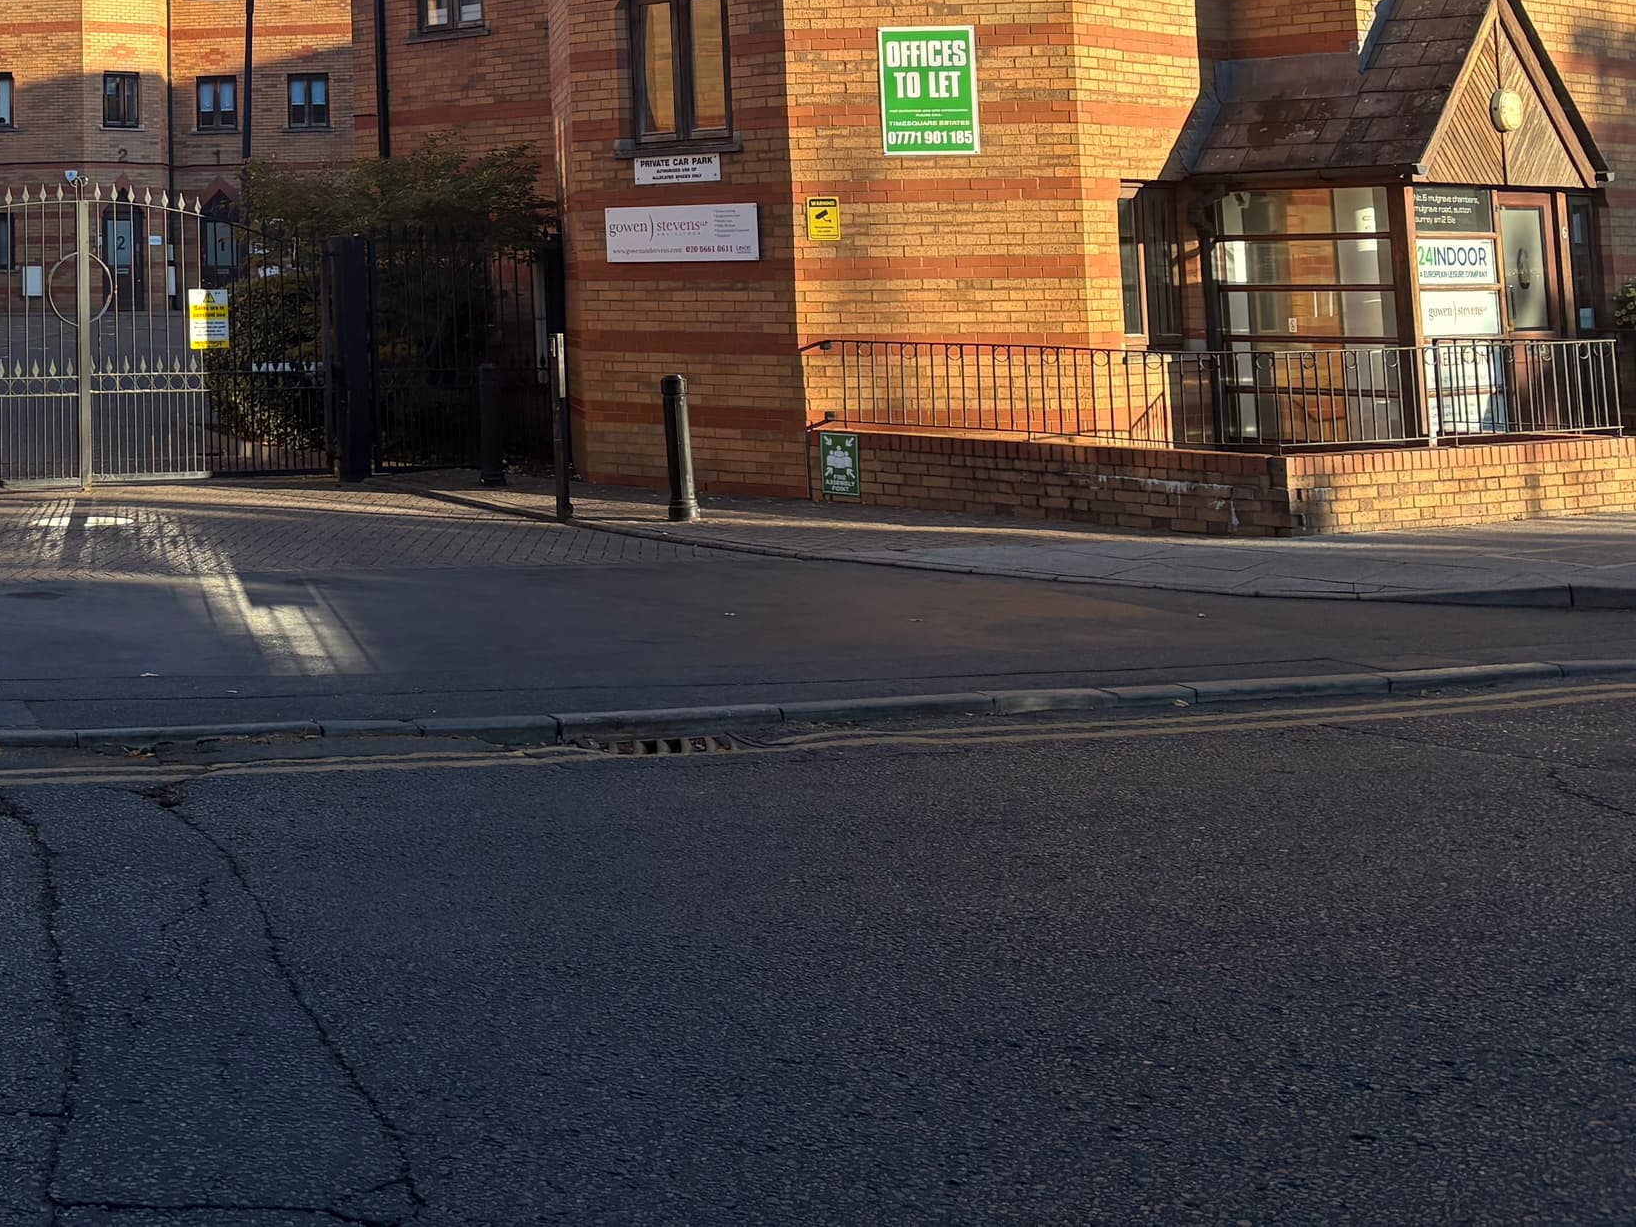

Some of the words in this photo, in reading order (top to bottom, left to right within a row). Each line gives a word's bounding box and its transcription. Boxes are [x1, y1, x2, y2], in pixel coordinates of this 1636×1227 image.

[886, 40, 966, 67] OFFICES
[893, 71, 921, 98] TO
[928, 71, 961, 98] LET
[888, 131, 921, 145] 07771
[924, 130, 948, 144] 901
[950, 130, 973, 144] 185
[118, 148, 128, 162] 2
[640, 159, 670, 168] PRIVATE
[673, 157, 689, 166] CAR
[692, 156, 713, 165] PARK
[609, 222, 648, 237] gowen
[656, 220, 700, 233] stevens
[117, 236, 125, 250] 2
[1417, 245, 1487, 266] 24INDOOR
[1424, 270, 1447, 278] EUROPEAN
[1465, 270, 1488, 278] COMPANY
[1428, 306, 1453, 321] gowen
[1457, 305, 1483, 317] stevens
